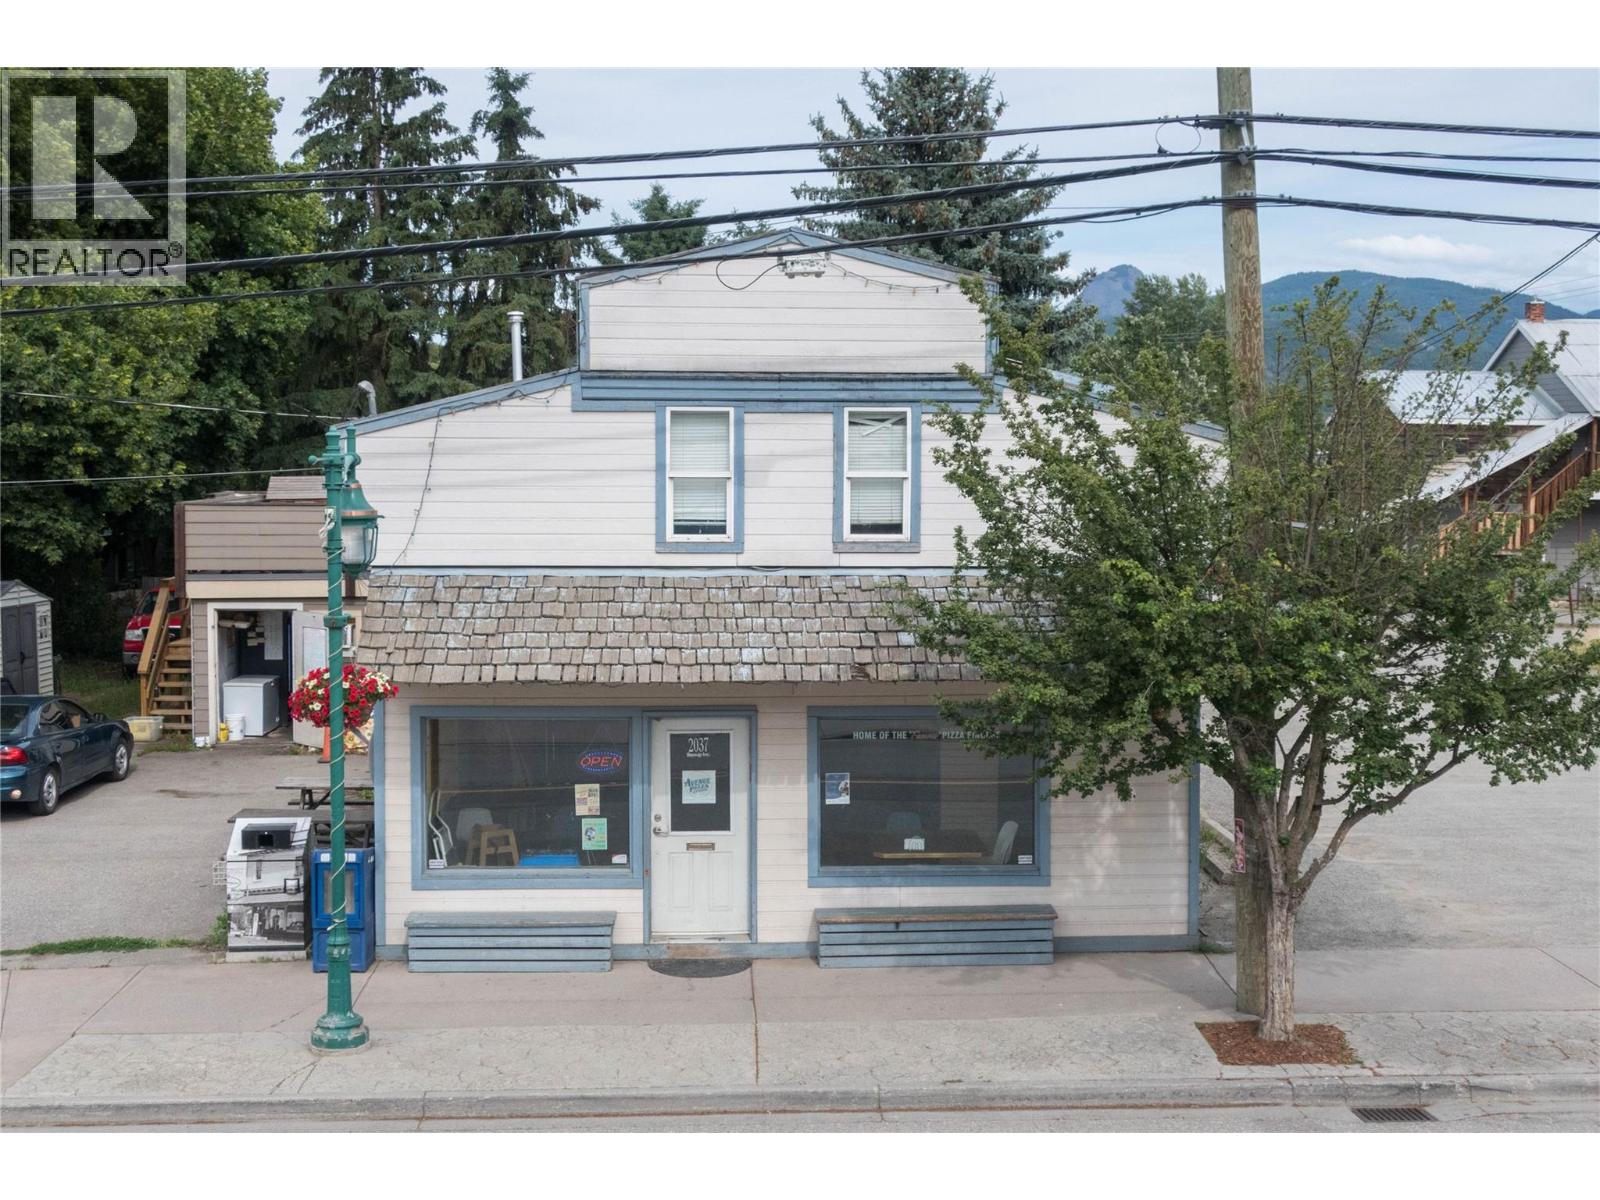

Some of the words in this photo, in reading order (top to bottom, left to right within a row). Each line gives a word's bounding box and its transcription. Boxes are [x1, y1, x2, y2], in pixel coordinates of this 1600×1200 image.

[852, 731, 877, 740] HOME
[879, 731, 890, 740] OF
[892, 731, 908, 740] THE
[942, 731, 965, 740] PIZZA
[688, 737, 710, 753] 2037
[579, 756, 623, 768] OPEN
